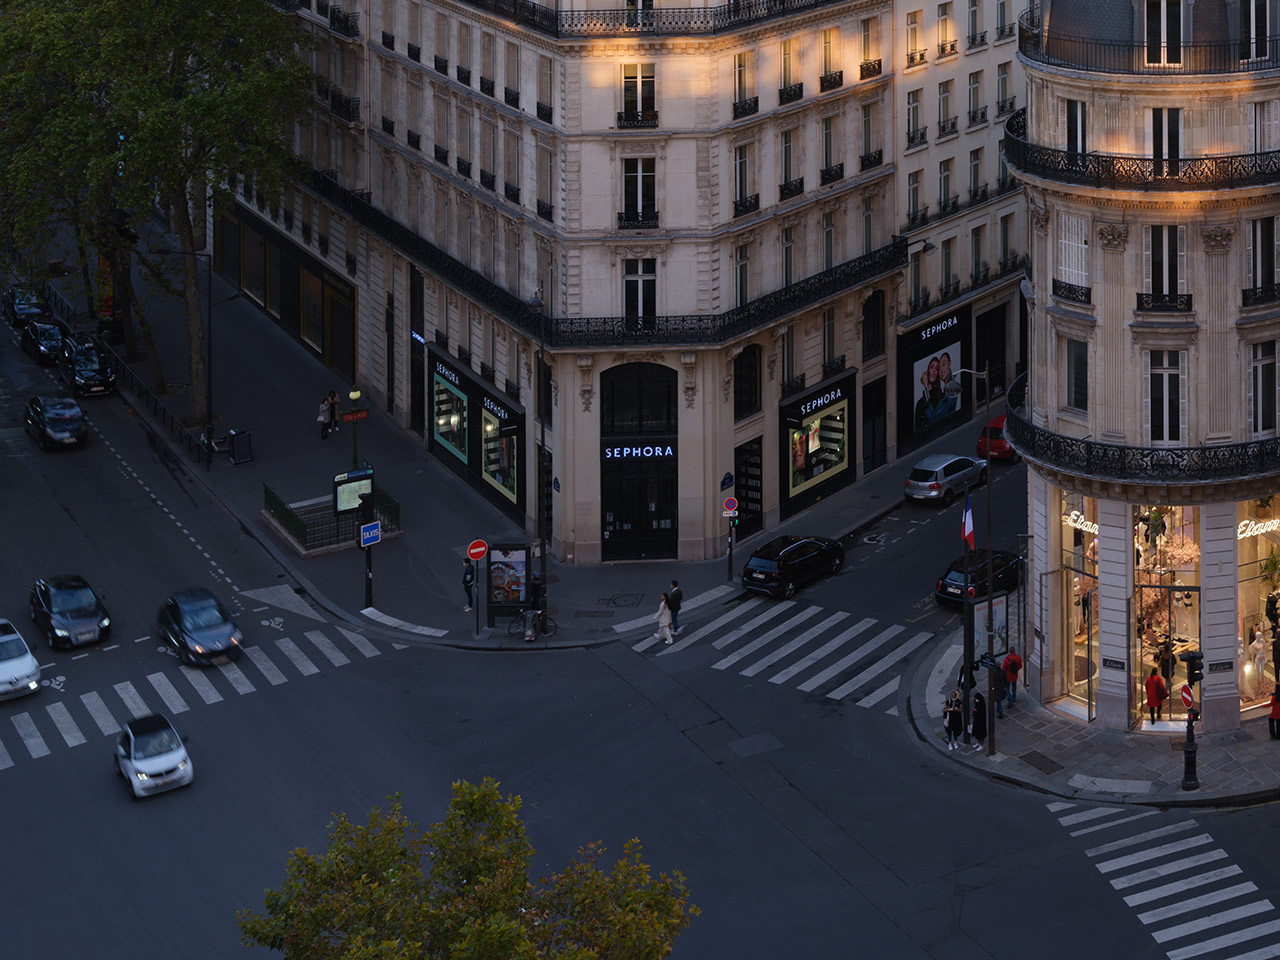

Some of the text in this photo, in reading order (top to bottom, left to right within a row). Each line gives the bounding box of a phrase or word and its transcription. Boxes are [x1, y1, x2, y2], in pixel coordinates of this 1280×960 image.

[921, 316, 958, 340] SEPHORA
[435, 361, 460, 386] SEPHORA
[483, 396, 509, 420] SEPHORA
[800, 388, 842, 415] SEPHORA
[605, 446, 673, 458] SEPHORA
[363, 528, 379, 540] TAXIS
[1236, 518, 1280, 540] Etam
